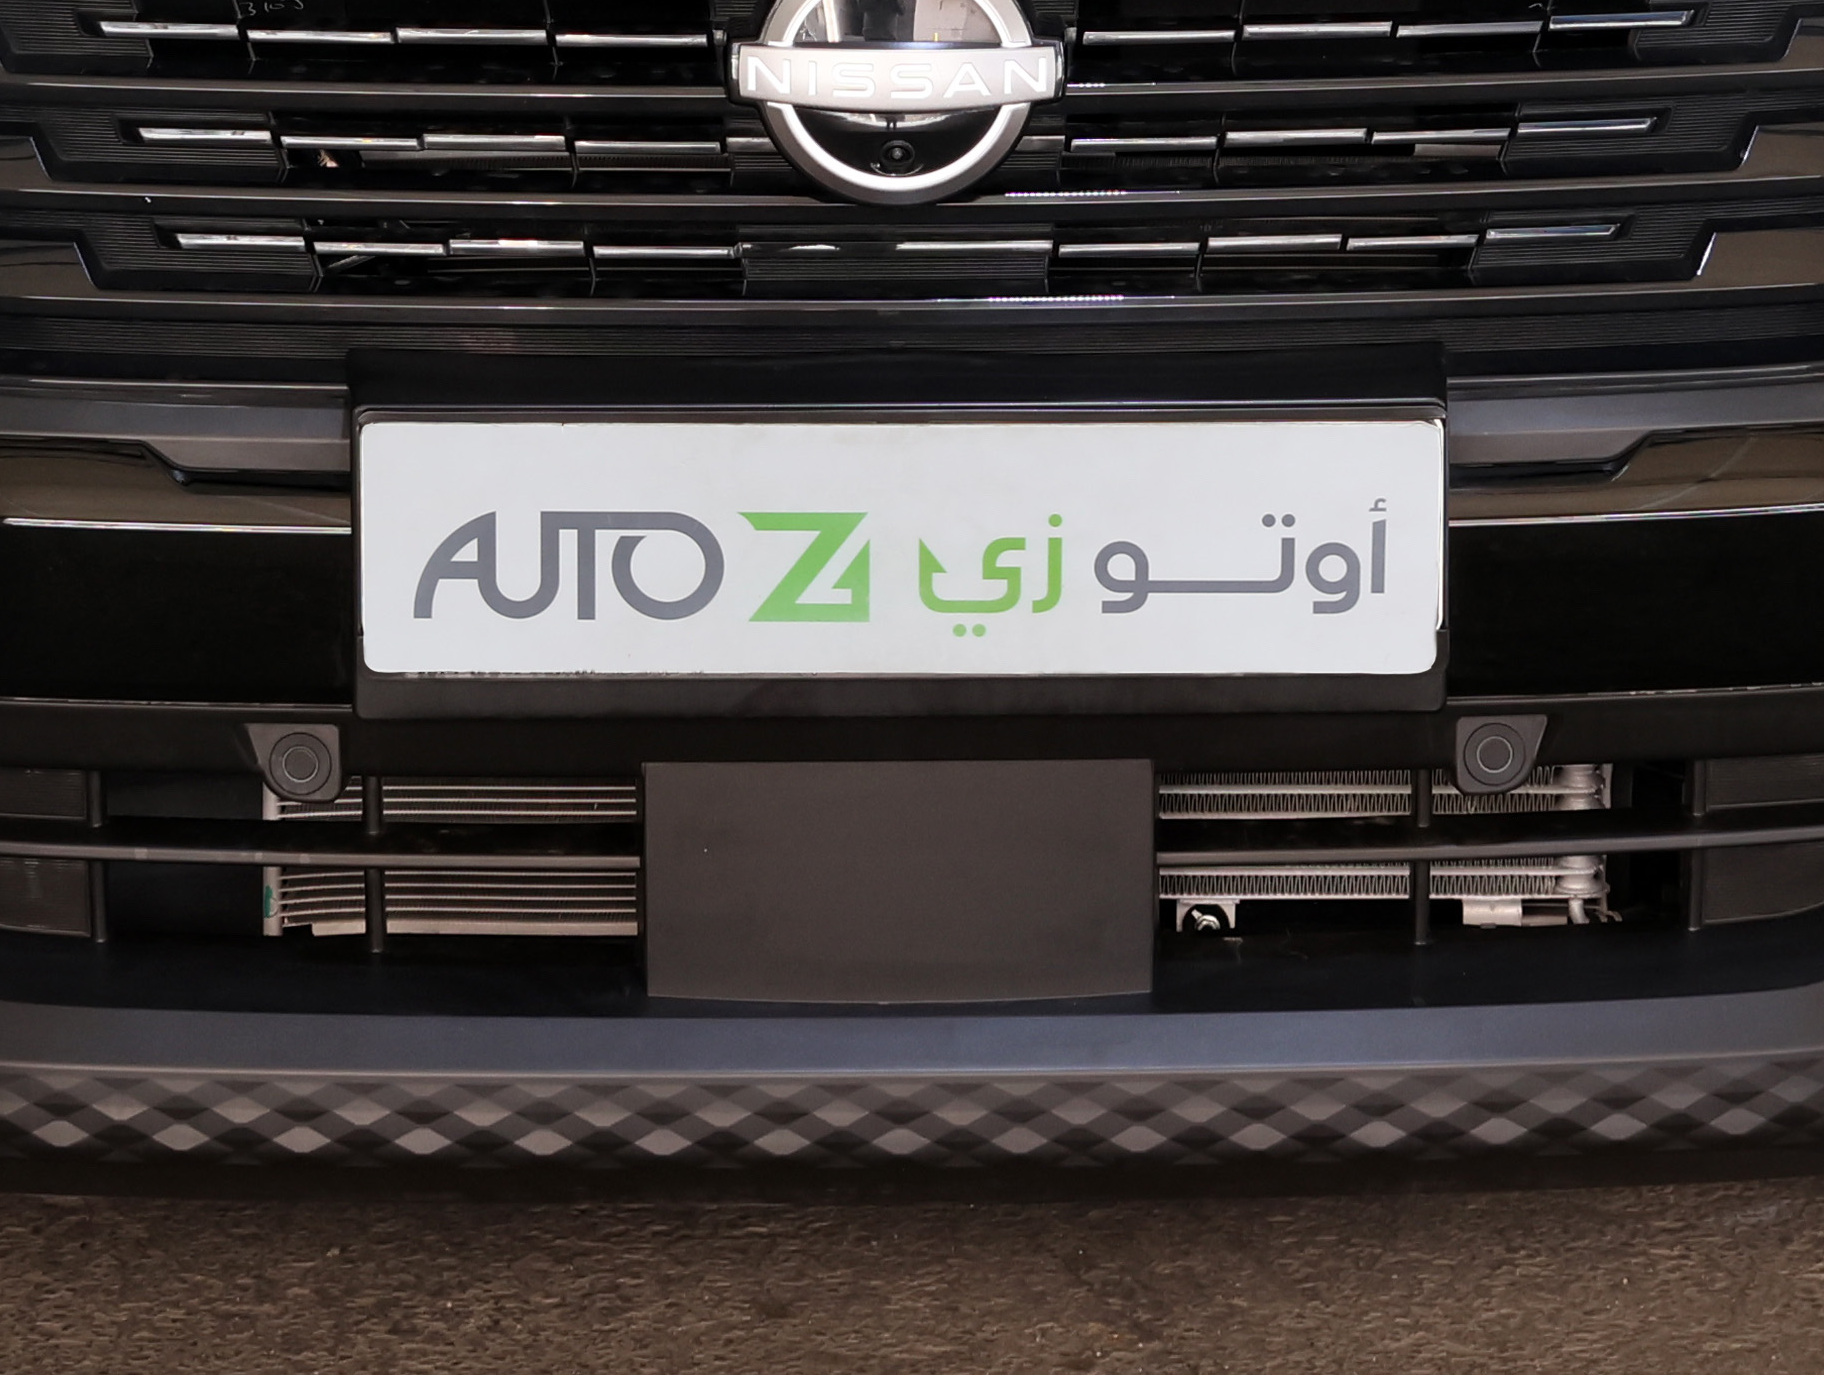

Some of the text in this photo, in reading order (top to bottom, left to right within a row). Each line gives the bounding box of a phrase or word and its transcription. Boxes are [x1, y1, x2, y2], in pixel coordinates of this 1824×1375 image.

[746, 55, 1048, 100] NISSAN
[413, 510, 725, 622] AUTO
[917, 513, 1064, 638] زي
